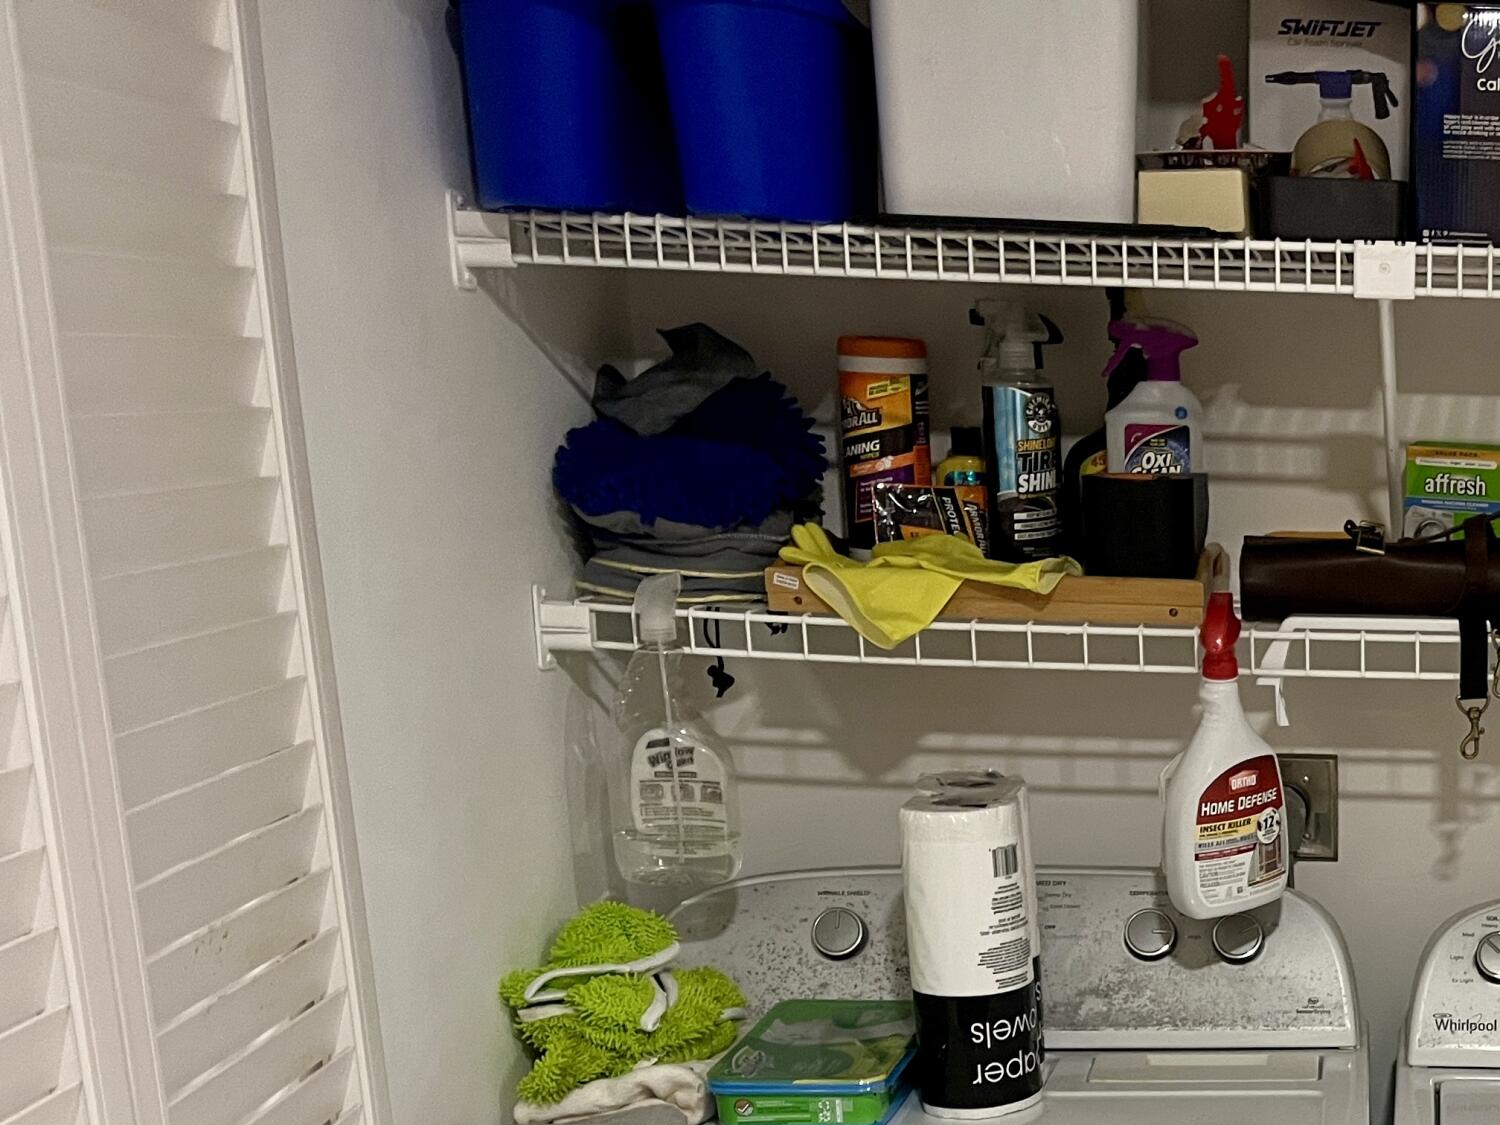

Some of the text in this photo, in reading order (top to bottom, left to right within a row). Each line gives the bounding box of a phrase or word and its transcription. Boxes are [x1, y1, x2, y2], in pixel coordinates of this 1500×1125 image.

[1142, 451, 1172, 469] OXI
[1018, 470, 1056, 493] SHIN
[1425, 473, 1486, 496] affresh
[1231, 775, 1257, 790] ORTHO
[1201, 787, 1278, 817] HOME DEFENSE
[1200, 818, 1252, 833] INSECT KILLER
[1263, 816, 1275, 829] 12
[970, 1008, 1037, 1049] owels
[1434, 1018, 1497, 1034] Whirlpool
[972, 1049, 1036, 1085] aper
